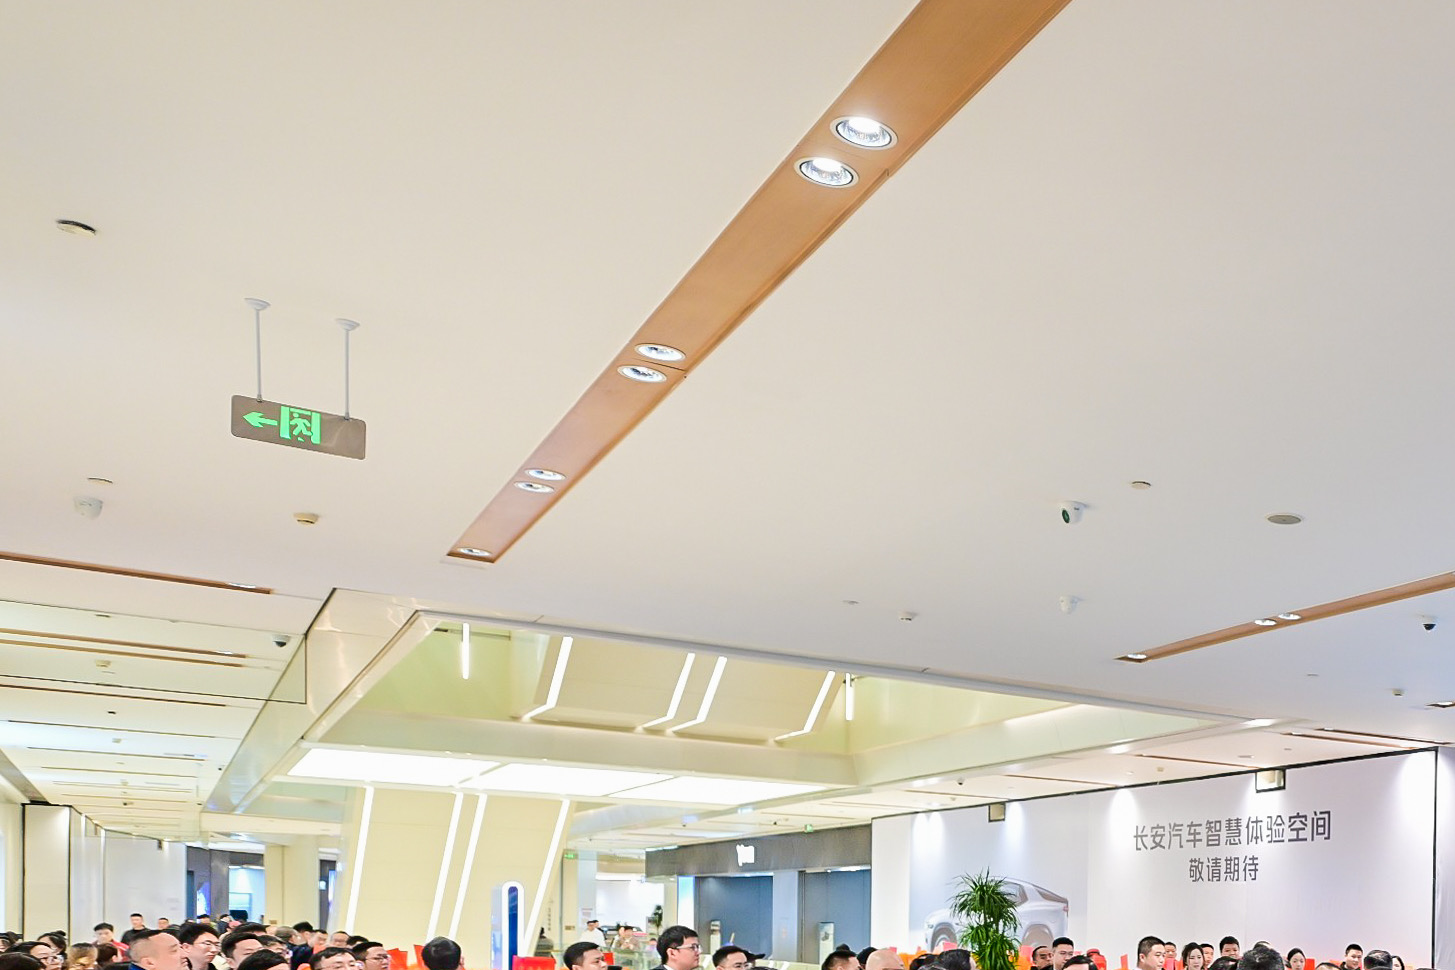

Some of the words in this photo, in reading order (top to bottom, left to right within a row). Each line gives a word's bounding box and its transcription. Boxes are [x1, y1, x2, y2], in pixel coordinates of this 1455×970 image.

[1133, 810, 1332, 851] 长安汽车智慧体验空间
[1188, 855, 1260, 883] 敬请期待
